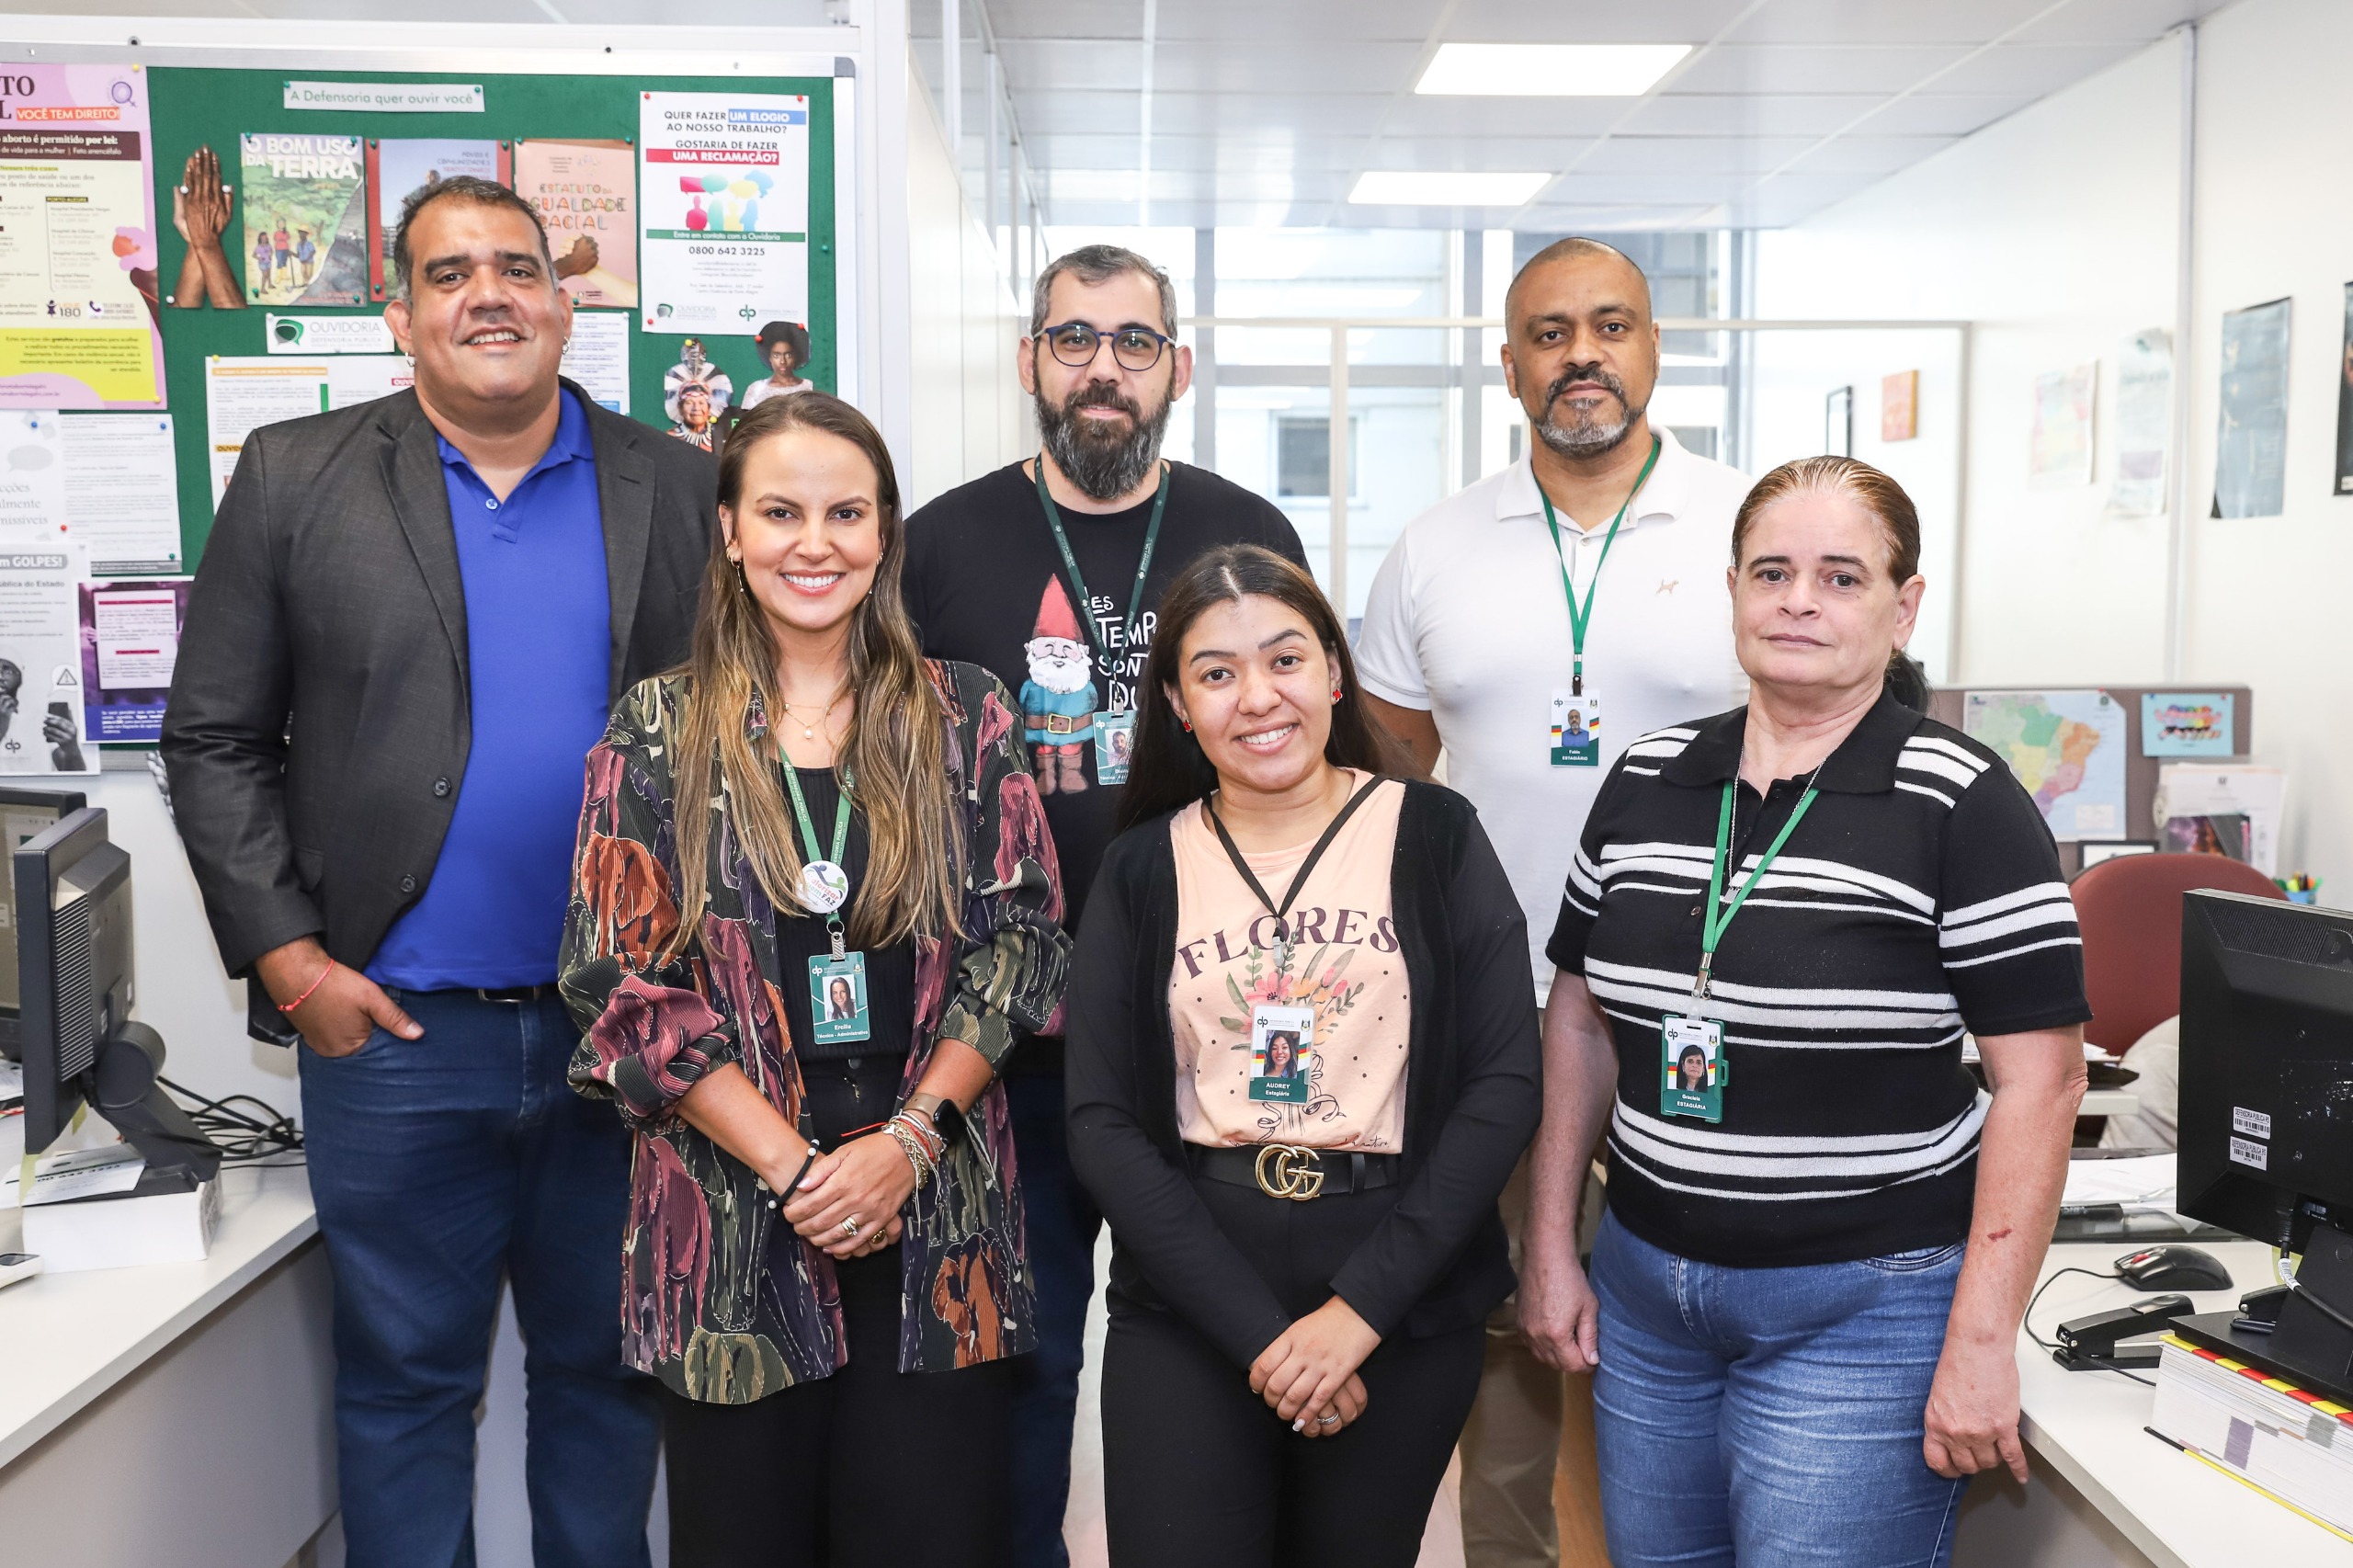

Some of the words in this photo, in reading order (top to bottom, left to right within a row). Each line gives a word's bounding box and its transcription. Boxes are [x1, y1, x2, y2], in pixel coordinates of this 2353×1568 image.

[0, 75, 35, 96] TO
[290, 91, 300, 101] A
[303, 90, 369, 104] Defensoria
[375, 95, 404, 106] quer
[408, 94, 439, 104] ouvir
[445, 93, 473, 104] você
[17, 108, 48, 120] VOCÊ
[50, 108, 74, 119] TEM
[75, 108, 119, 120] DIREITO!
[665, 111, 692, 120] QUER
[696, 111, 726, 120] FAZER
[730, 112, 747, 121] UM
[750, 113, 790, 123] ELOGIO
[666, 123, 682, 131] AO
[686, 123, 723, 132] NOSSO
[727, 124, 787, 133] TRABALHO?
[2, 134, 32, 143] aborto
[33, 134, 39, 143] é
[40, 135, 85, 146] permitido
[85, 137, 102, 146] por
[103, 135, 119, 145] lei:
[245, 137, 261, 154] O
[267, 138, 312, 155] BOM
[315, 139, 358, 155] USO
[676, 140, 727, 149] GOSTARIA
[731, 141, 744, 149] DE
[747, 142, 778, 150] FAZER
[673, 151, 699, 161] UMA
[700, 151, 778, 165] RECLAMAÇÃO?
[246, 155, 266, 167] DA
[268, 154, 359, 180] TERRA
[540, 183, 601, 194] ESTATUTO
[527, 197, 627, 212] GUALDADE
[748, 233, 780, 241] Ouvidoria
[688, 246, 714, 256] 0800
[718, 246, 736, 256] 642
[740, 247, 765, 256] 3225
[60, 308, 81, 317] 180
[310, 322, 381, 333] OUVIDORIA
[12, 556, 63, 567] GOLPES!
[1095, 611, 1157, 649] TEMP
[821, 893, 835, 906] FAZ
[1177, 906, 1399, 979] FLORES
